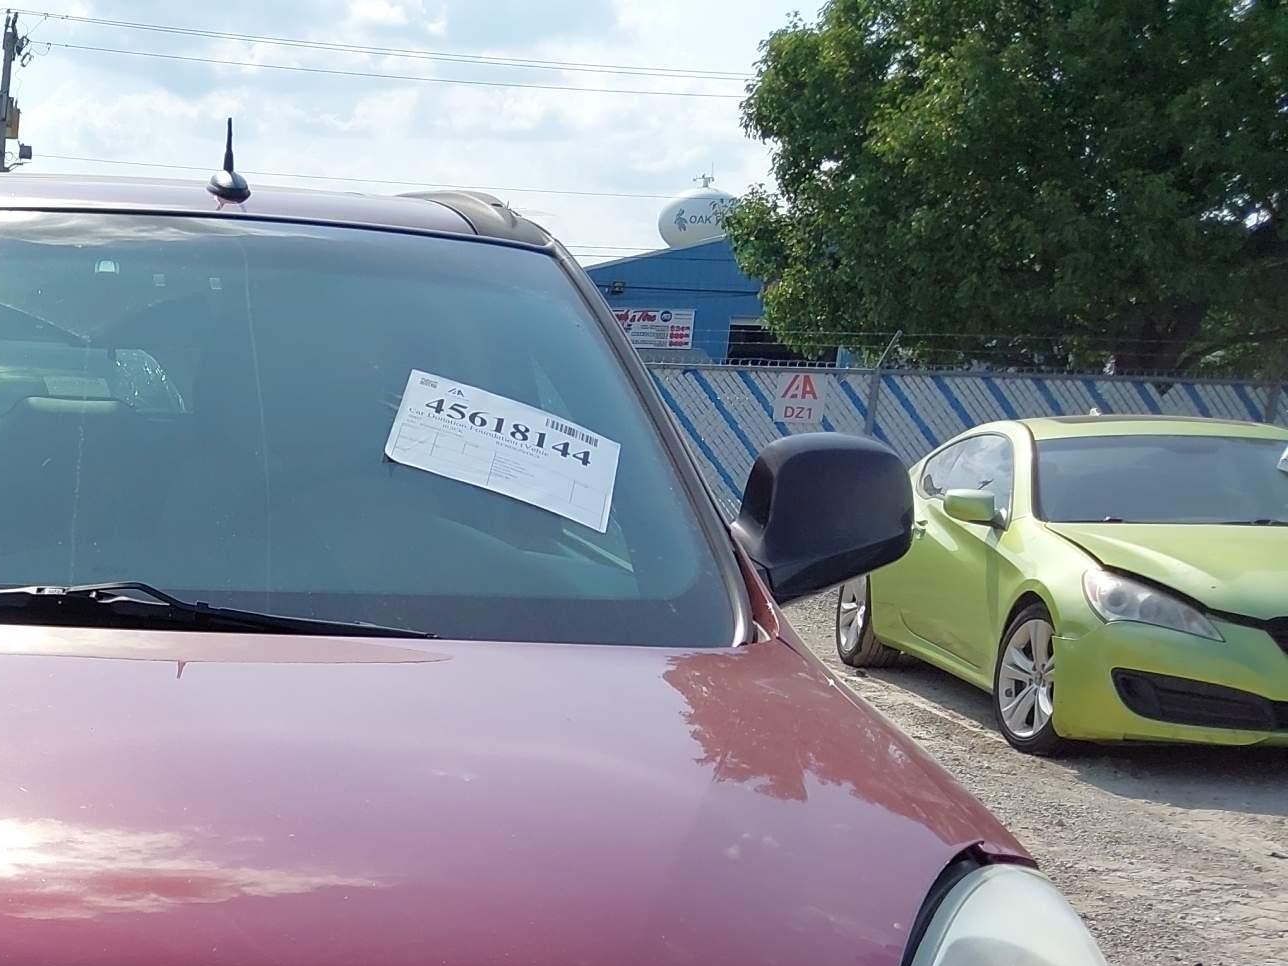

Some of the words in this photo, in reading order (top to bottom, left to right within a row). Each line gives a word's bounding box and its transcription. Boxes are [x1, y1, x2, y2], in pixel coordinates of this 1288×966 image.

[689, 215, 712, 225] OAK
[784, 406, 812, 420] DZ1
[425, 398, 592, 467] 45618144
